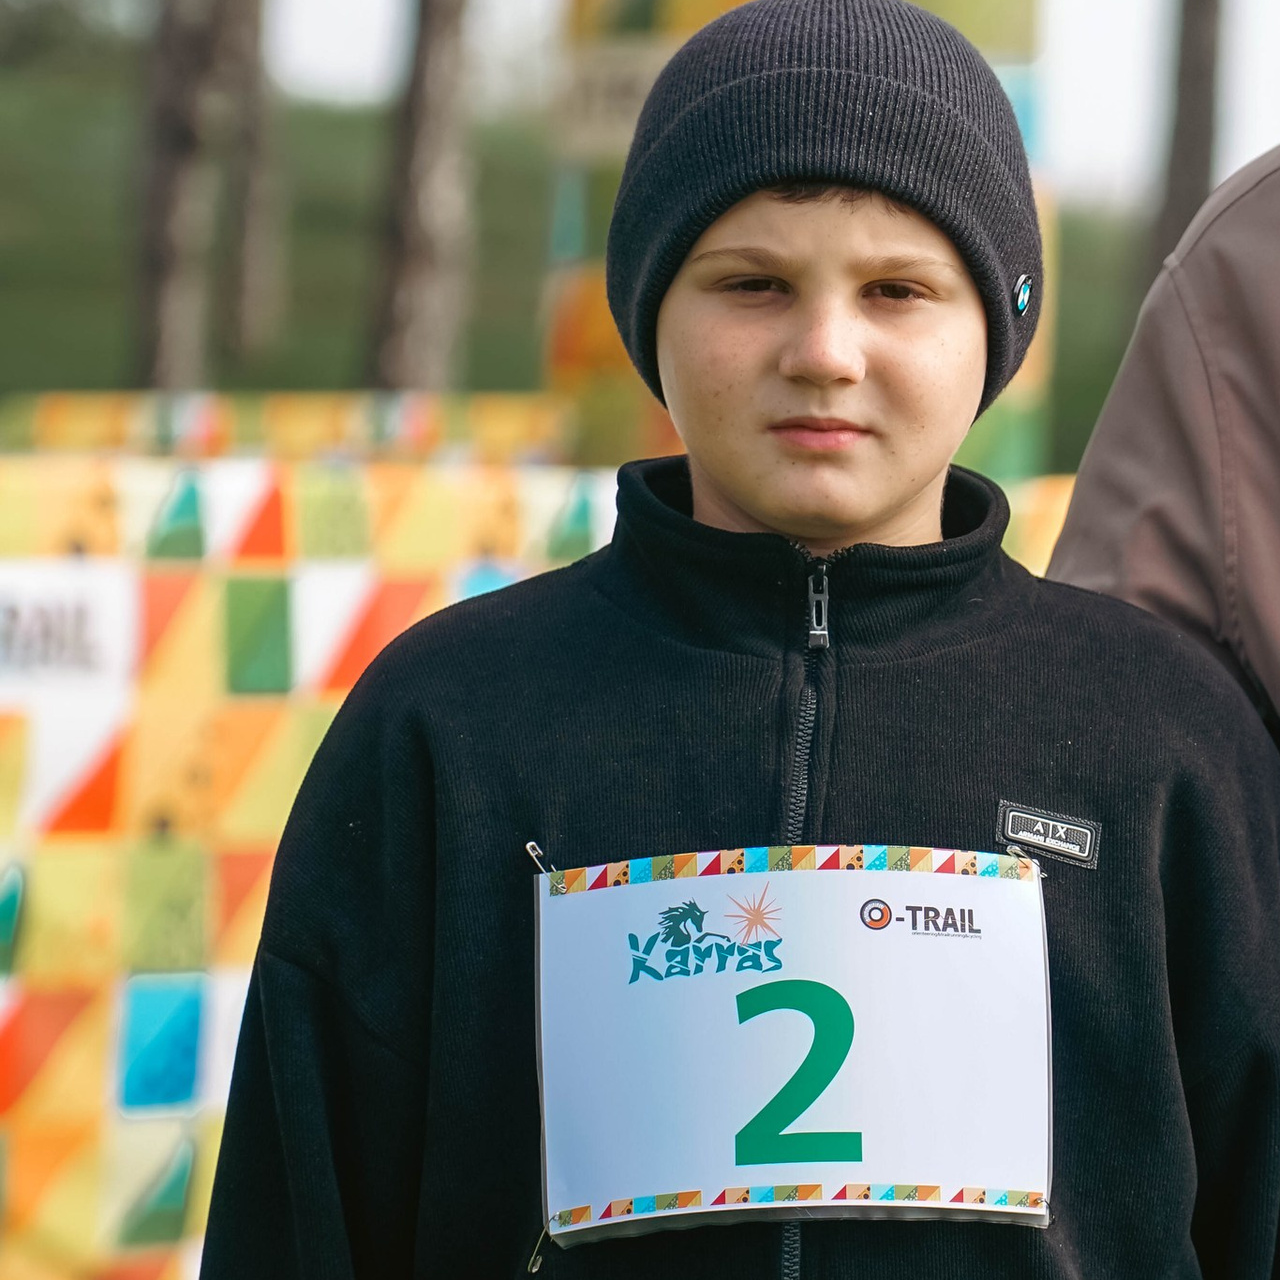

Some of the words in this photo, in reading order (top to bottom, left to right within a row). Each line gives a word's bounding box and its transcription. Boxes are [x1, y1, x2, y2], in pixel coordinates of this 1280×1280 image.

[1018, 831, 1045, 843] ARMANI
[1045, 837, 1080, 852] EXCHANGE
[860, 898, 981, 933] O-TRAIL
[628, 931, 783, 984] Karras
[734, 978, 863, 1167] 2
